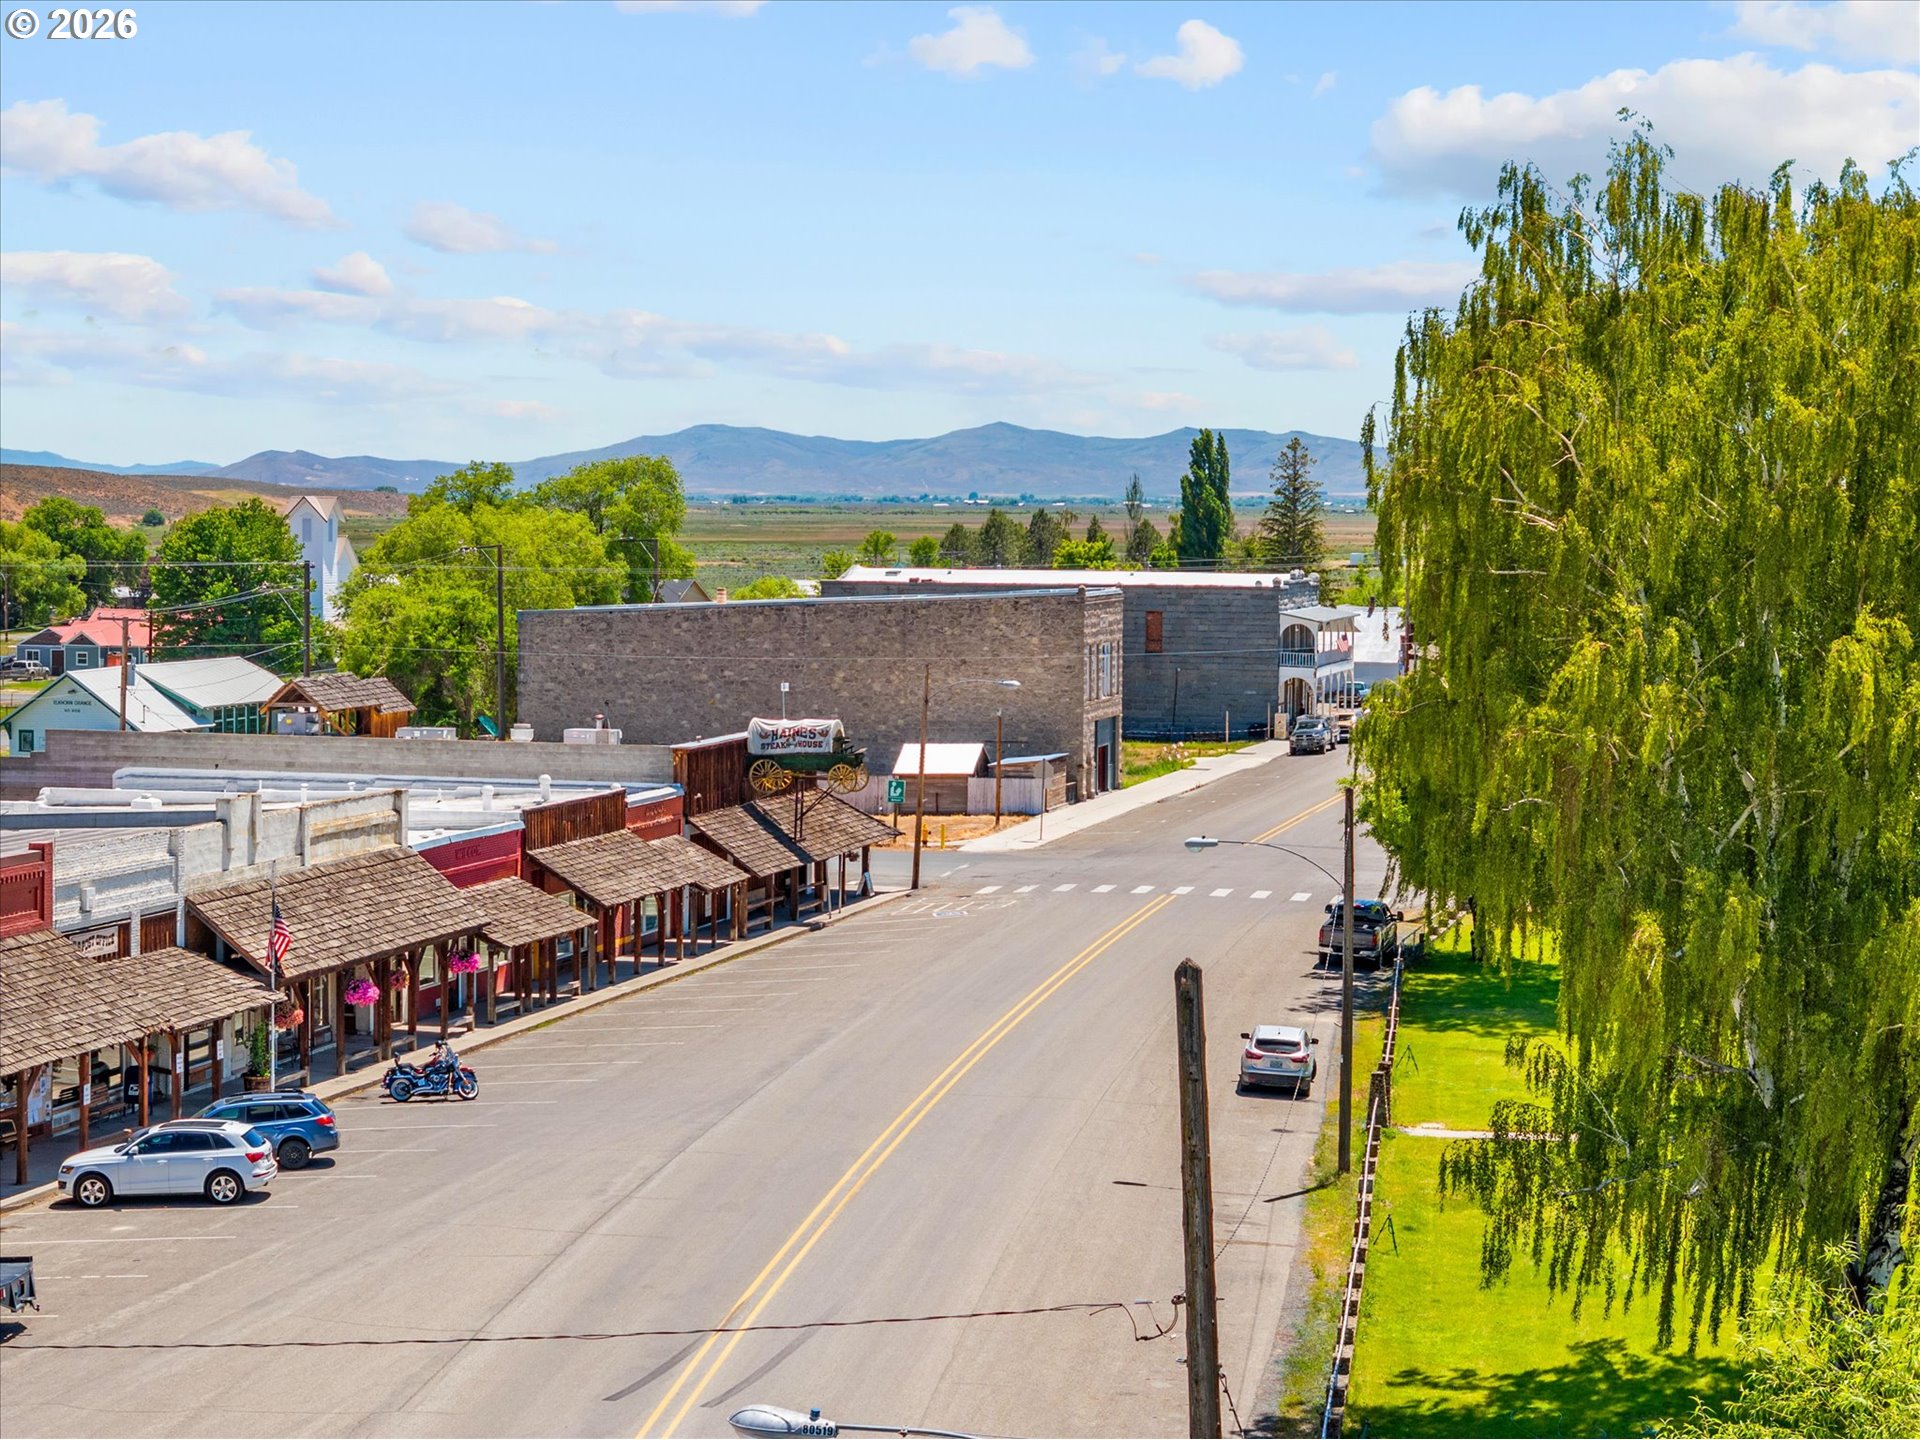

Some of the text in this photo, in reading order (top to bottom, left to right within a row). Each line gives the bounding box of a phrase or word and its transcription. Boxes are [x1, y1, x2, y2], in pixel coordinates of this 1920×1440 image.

[770, 727, 817, 742] HAINES
[760, 741, 787, 750] STEAK
[82, 935, 96, 952] POST
[96, 933, 115, 947] OFFICE
[802, 1424, 834, 1436] 80519
